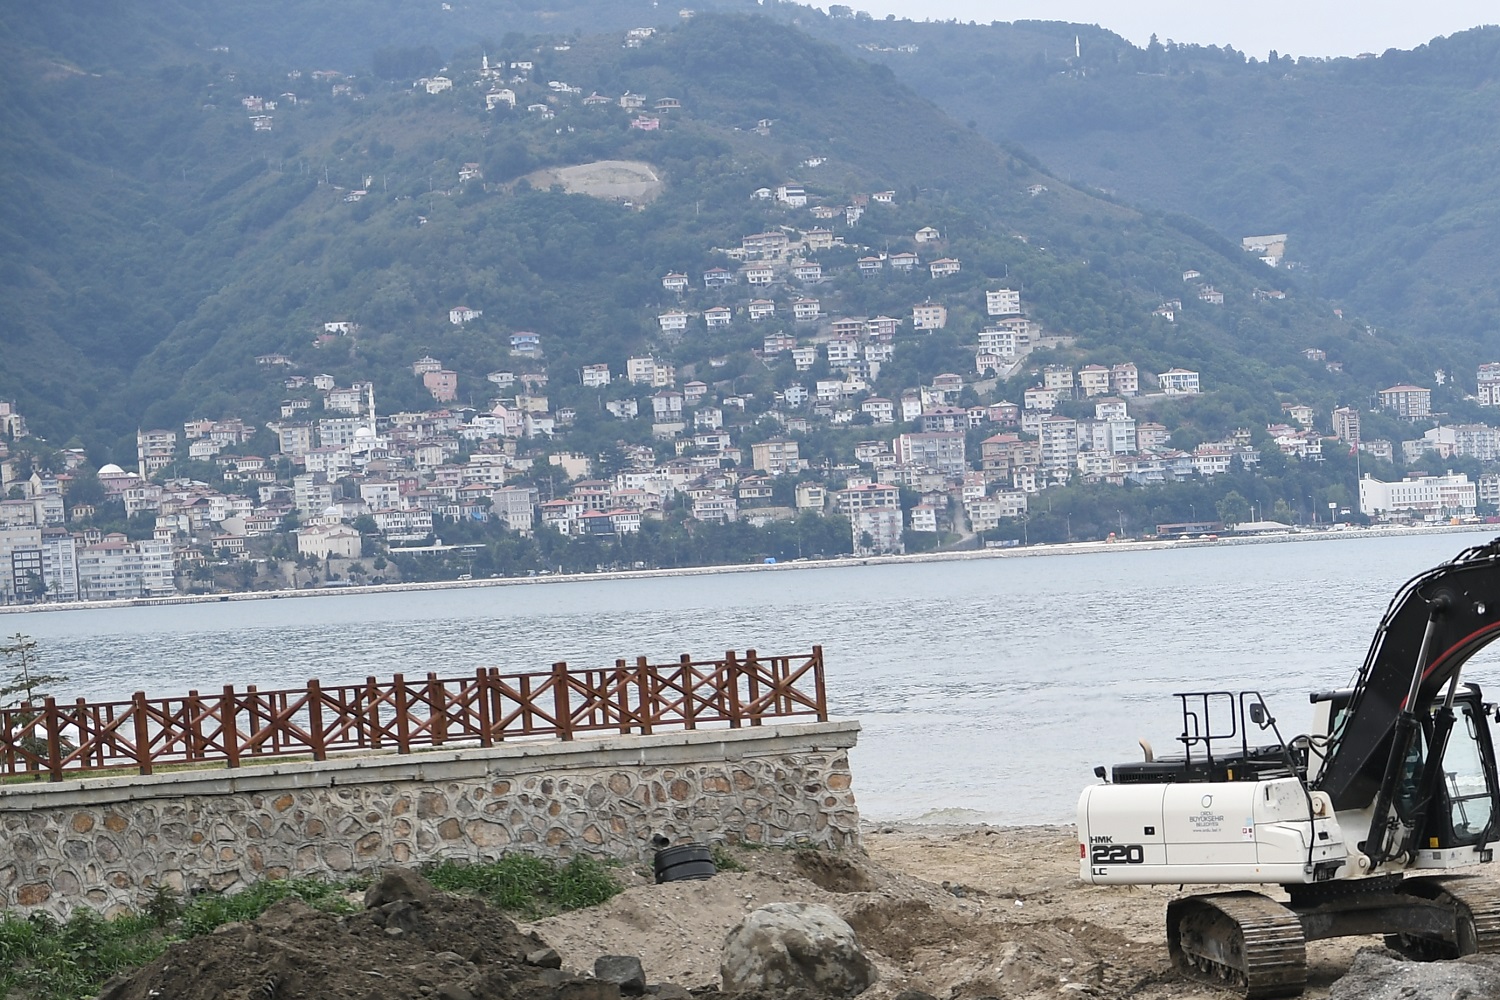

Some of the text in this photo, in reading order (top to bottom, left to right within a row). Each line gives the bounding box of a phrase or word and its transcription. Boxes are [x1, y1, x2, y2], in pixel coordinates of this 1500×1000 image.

[1090, 836, 1113, 844] HMK
[1092, 845, 1145, 865] 220
[1092, 867, 1108, 876] LC
